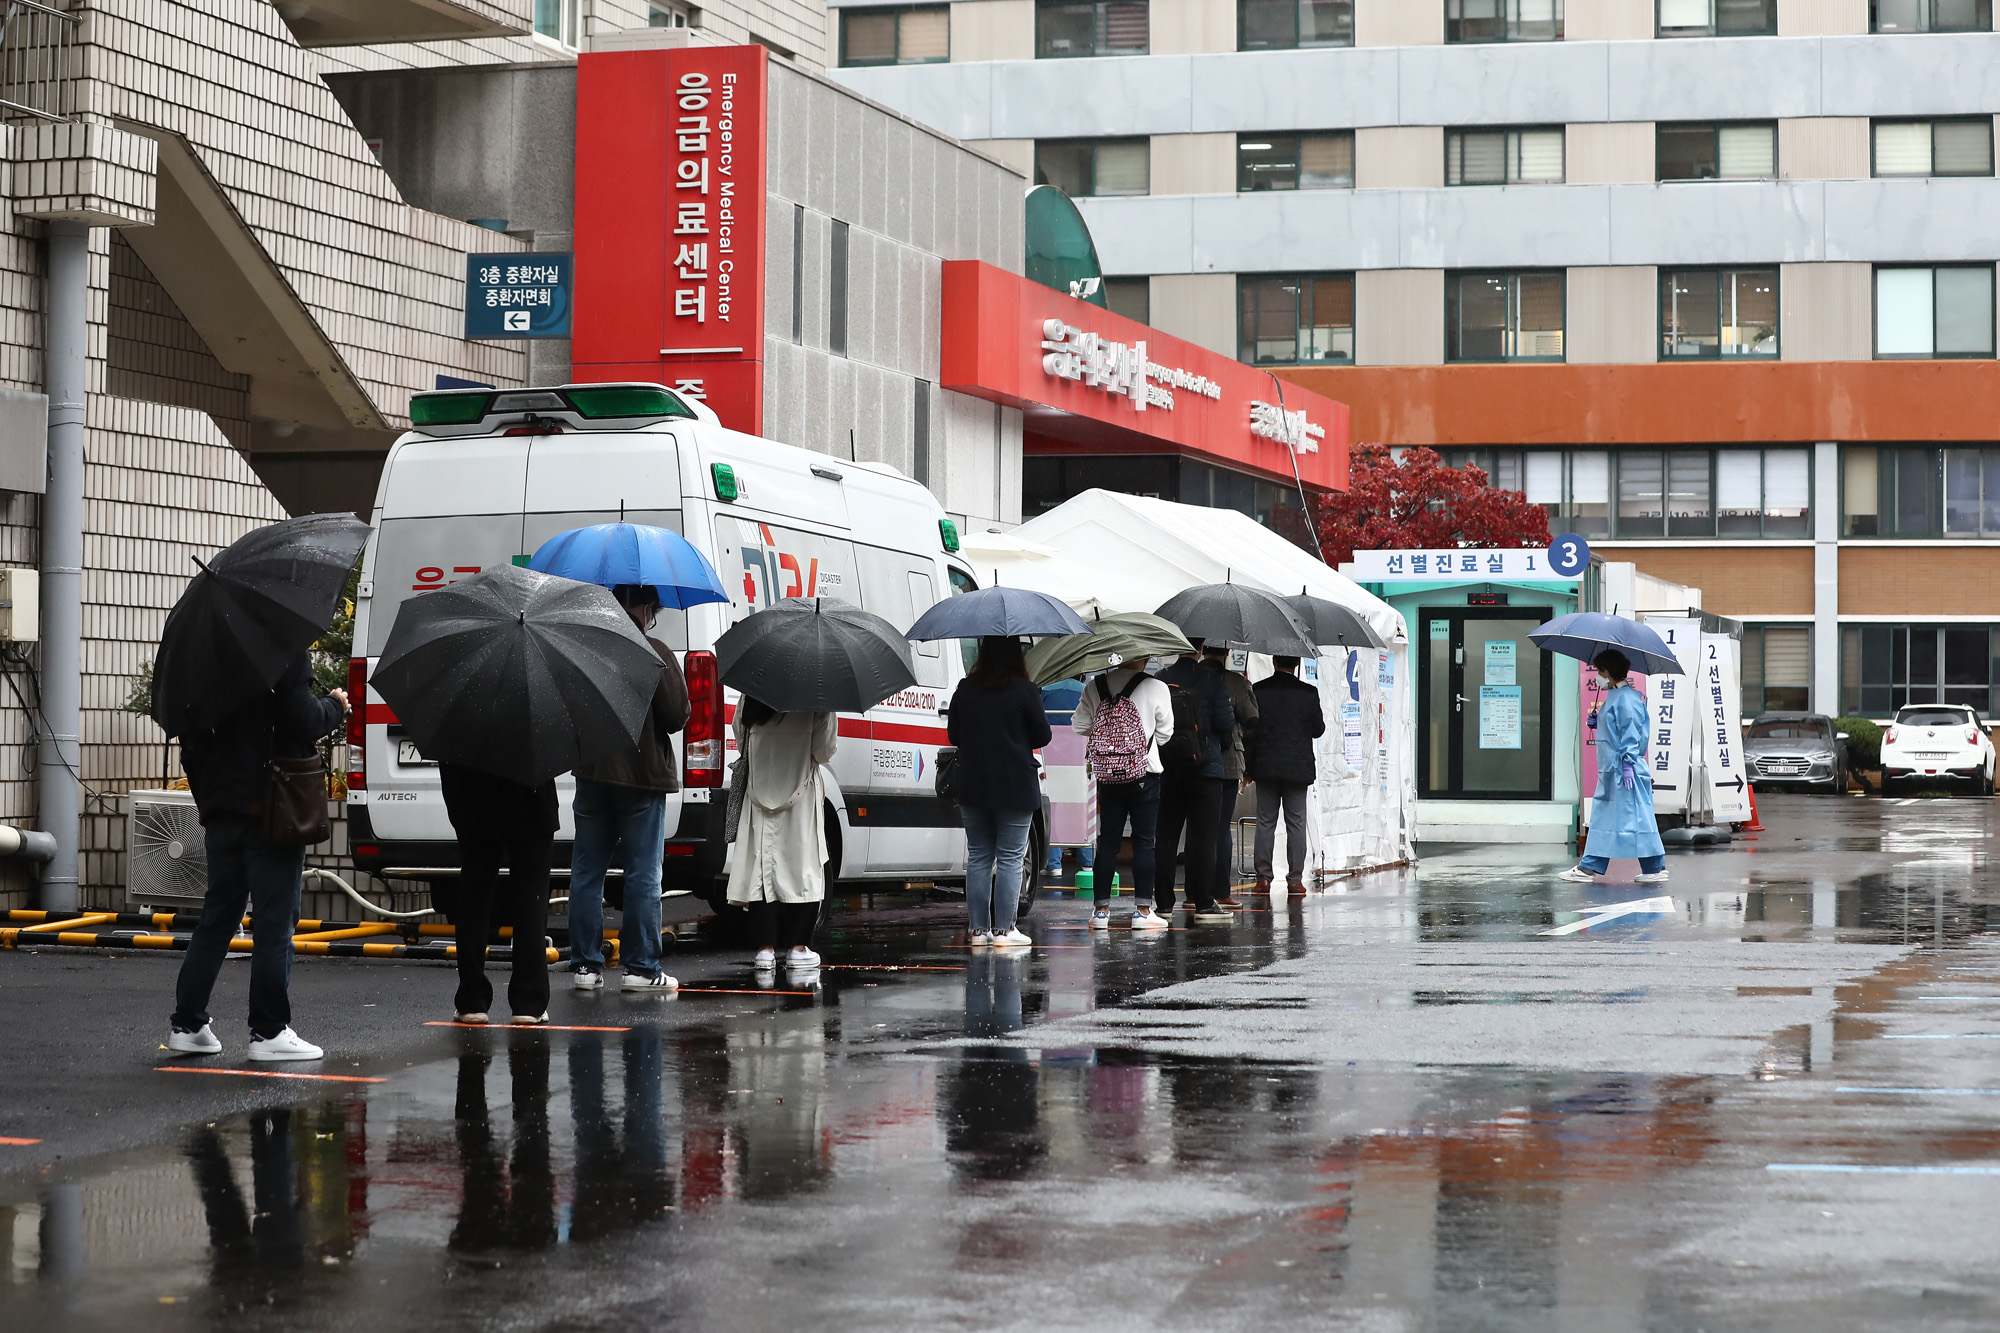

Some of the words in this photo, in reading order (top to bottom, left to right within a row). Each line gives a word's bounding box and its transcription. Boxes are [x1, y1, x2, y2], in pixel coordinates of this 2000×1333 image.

[718, 73, 737, 176] Emergency
[673, 72, 712, 323] 응급의료센터
[719, 182, 735, 254] Medical
[479, 265, 501, 285] 3층
[506, 265, 559, 285] 중환자실
[485, 287, 551, 308] 중환자면회
[718, 260, 734, 323] Center
[1041, 318, 1147, 411] 응급의료센터
[1386, 553, 1505, 575] 선별진료실
[1526, 554, 1536, 571] 1
[1560, 541, 1578, 568] 3
[1666, 629, 1676, 645] 1
[1708, 644, 1717, 660] 2
[1654, 679, 1676, 771] 별진료실
[1708, 664, 1731, 768] 선별진료실
[873, 748, 913, 770] 국립중앙의료원
[377, 793, 418, 801] AUTECH
